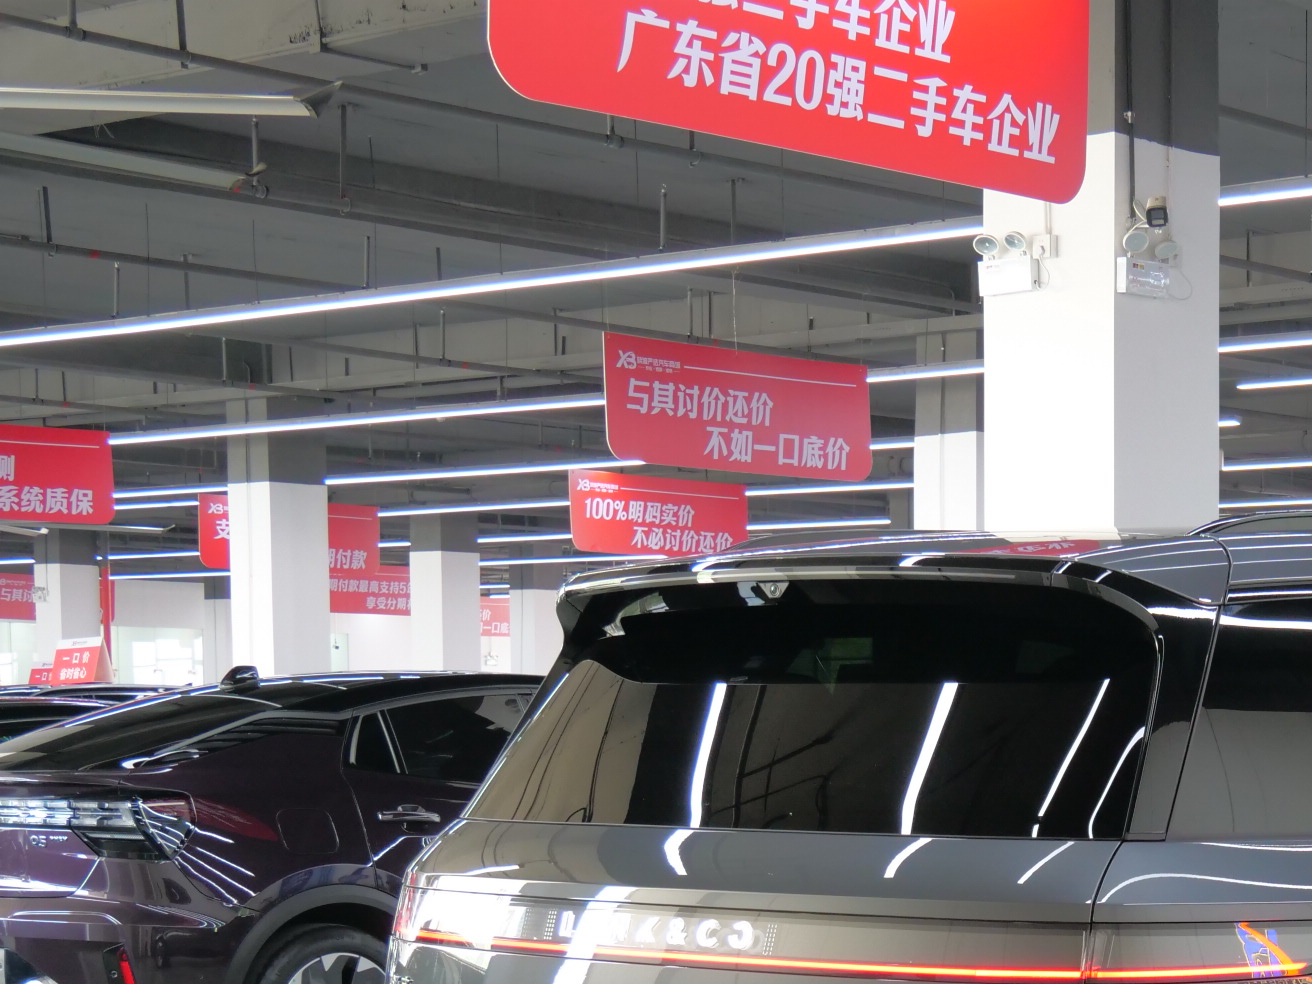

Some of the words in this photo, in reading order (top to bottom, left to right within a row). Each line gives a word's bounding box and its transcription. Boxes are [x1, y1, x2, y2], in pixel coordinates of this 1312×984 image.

[616, 9, 1061, 165] 广东省20强二手车企业
[626, 378, 774, 427] 与其讨价还价
[703, 426, 851, 471] 不如一口底价
[584, 497, 695, 528] 100%明码实价
[631, 526, 734, 554] 不必讨价还价
